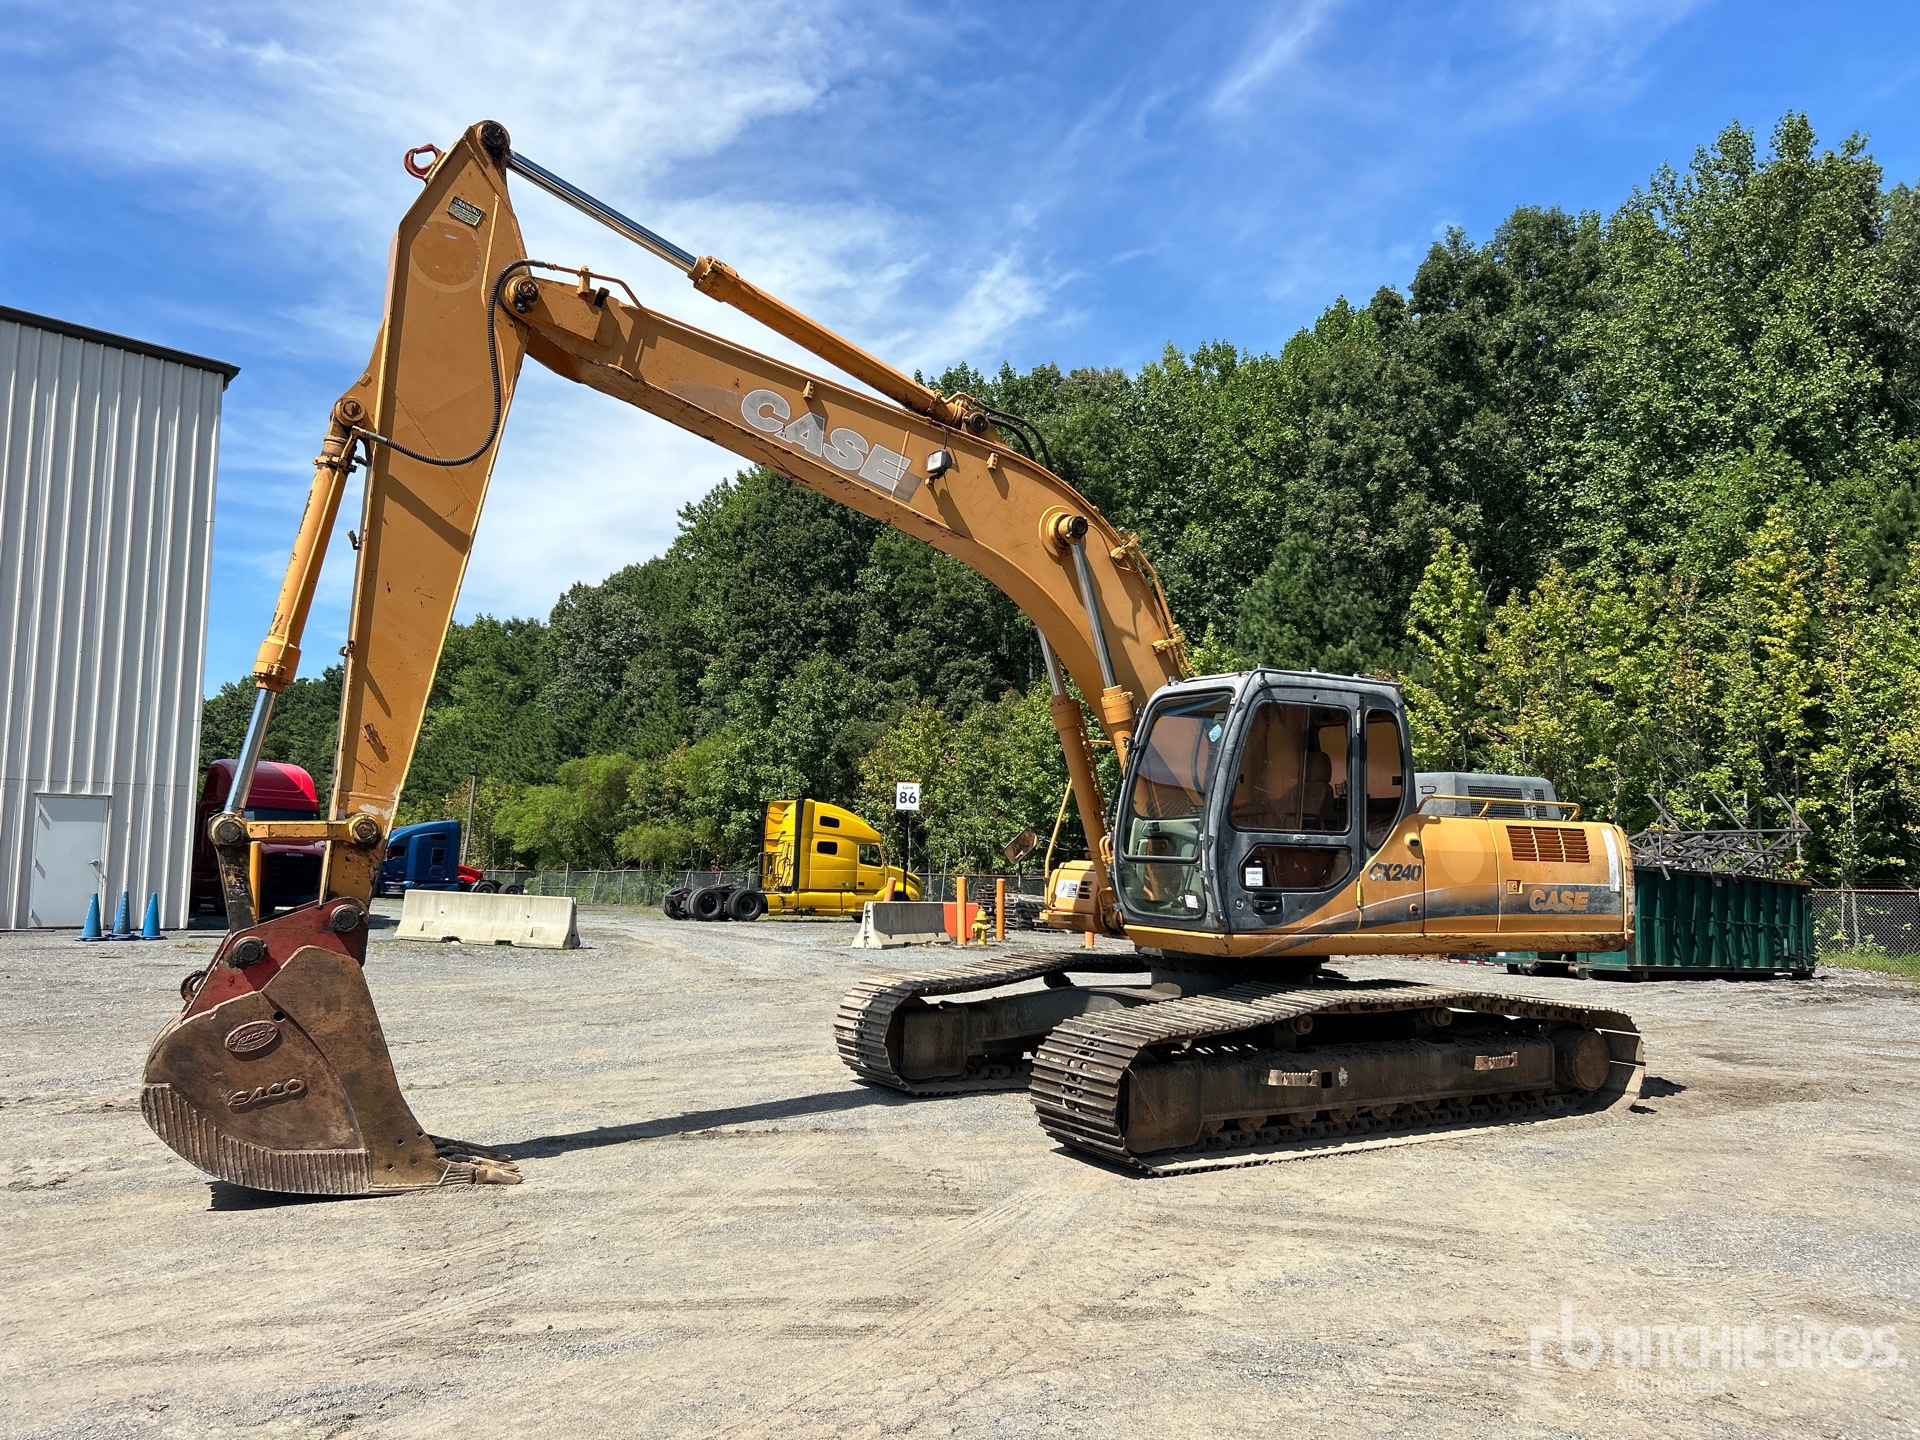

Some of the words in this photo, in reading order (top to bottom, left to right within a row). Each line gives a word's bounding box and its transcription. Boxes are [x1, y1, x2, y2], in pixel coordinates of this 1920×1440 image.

[453, 198, 480, 215] WARNING
[740, 388, 912, 491] CASE
[899, 791, 916, 803] 86
[1368, 862, 1422, 881] CX240
[1529, 889, 1589, 911] CASE
